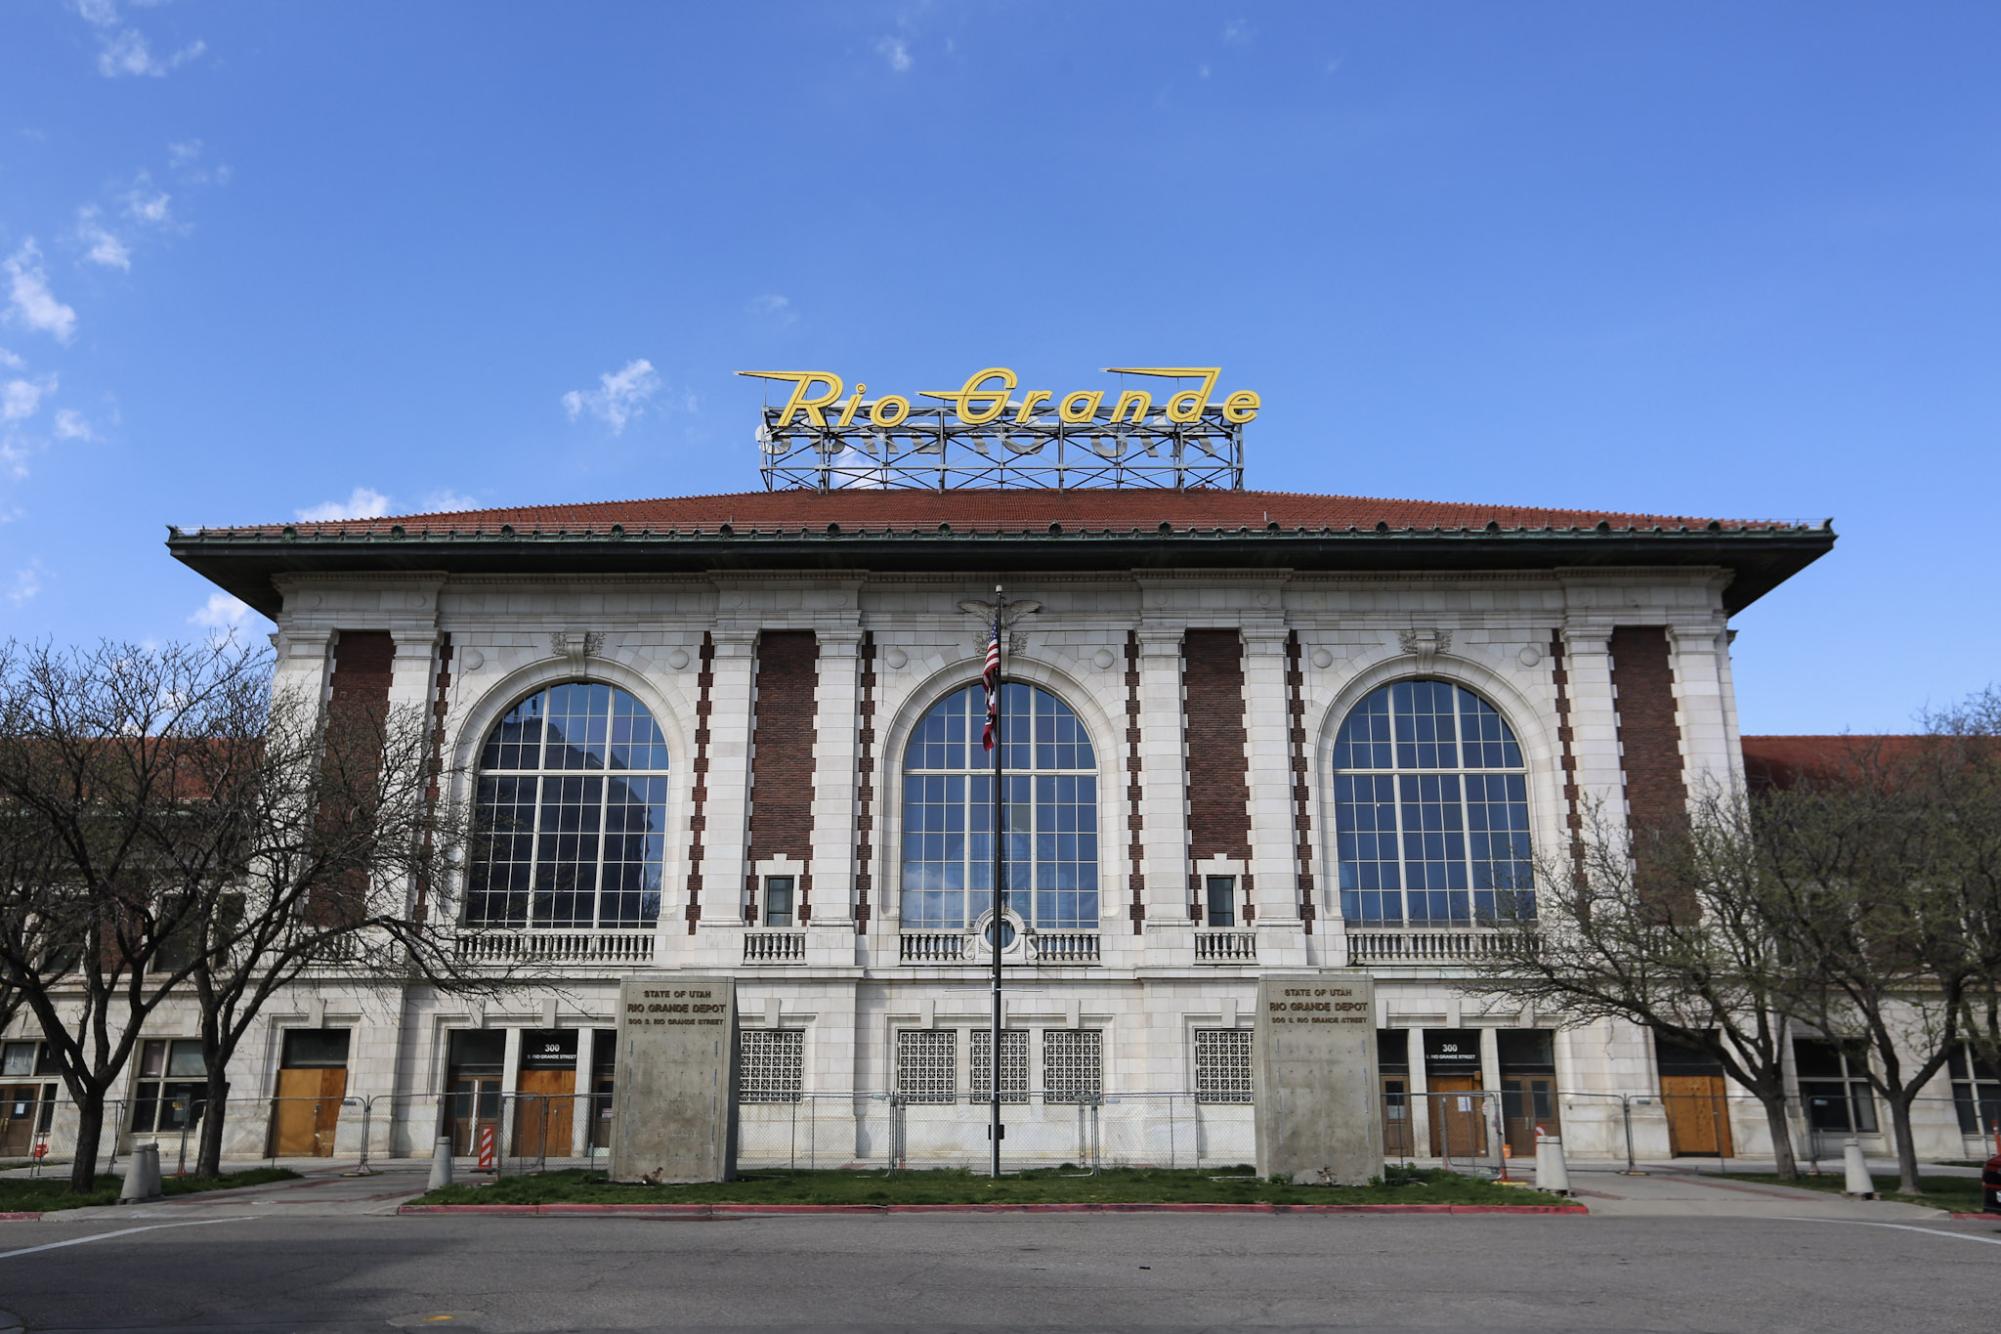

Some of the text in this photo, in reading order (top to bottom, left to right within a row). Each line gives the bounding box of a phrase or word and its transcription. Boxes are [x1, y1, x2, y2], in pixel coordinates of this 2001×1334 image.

[734, 367, 1261, 428] Rio Grande
[644, 990, 712, 999] STATE OF UTAH
[1284, 989, 1352, 997] STATE OF UTAH
[627, 1003, 726, 1013] RIO GRANDE DEPOT
[1269, 1002, 1368, 1012] RIO GRANDE DEPOT
[544, 1043, 560, 1052] 300
[1442, 1043, 1458, 1052] 300
